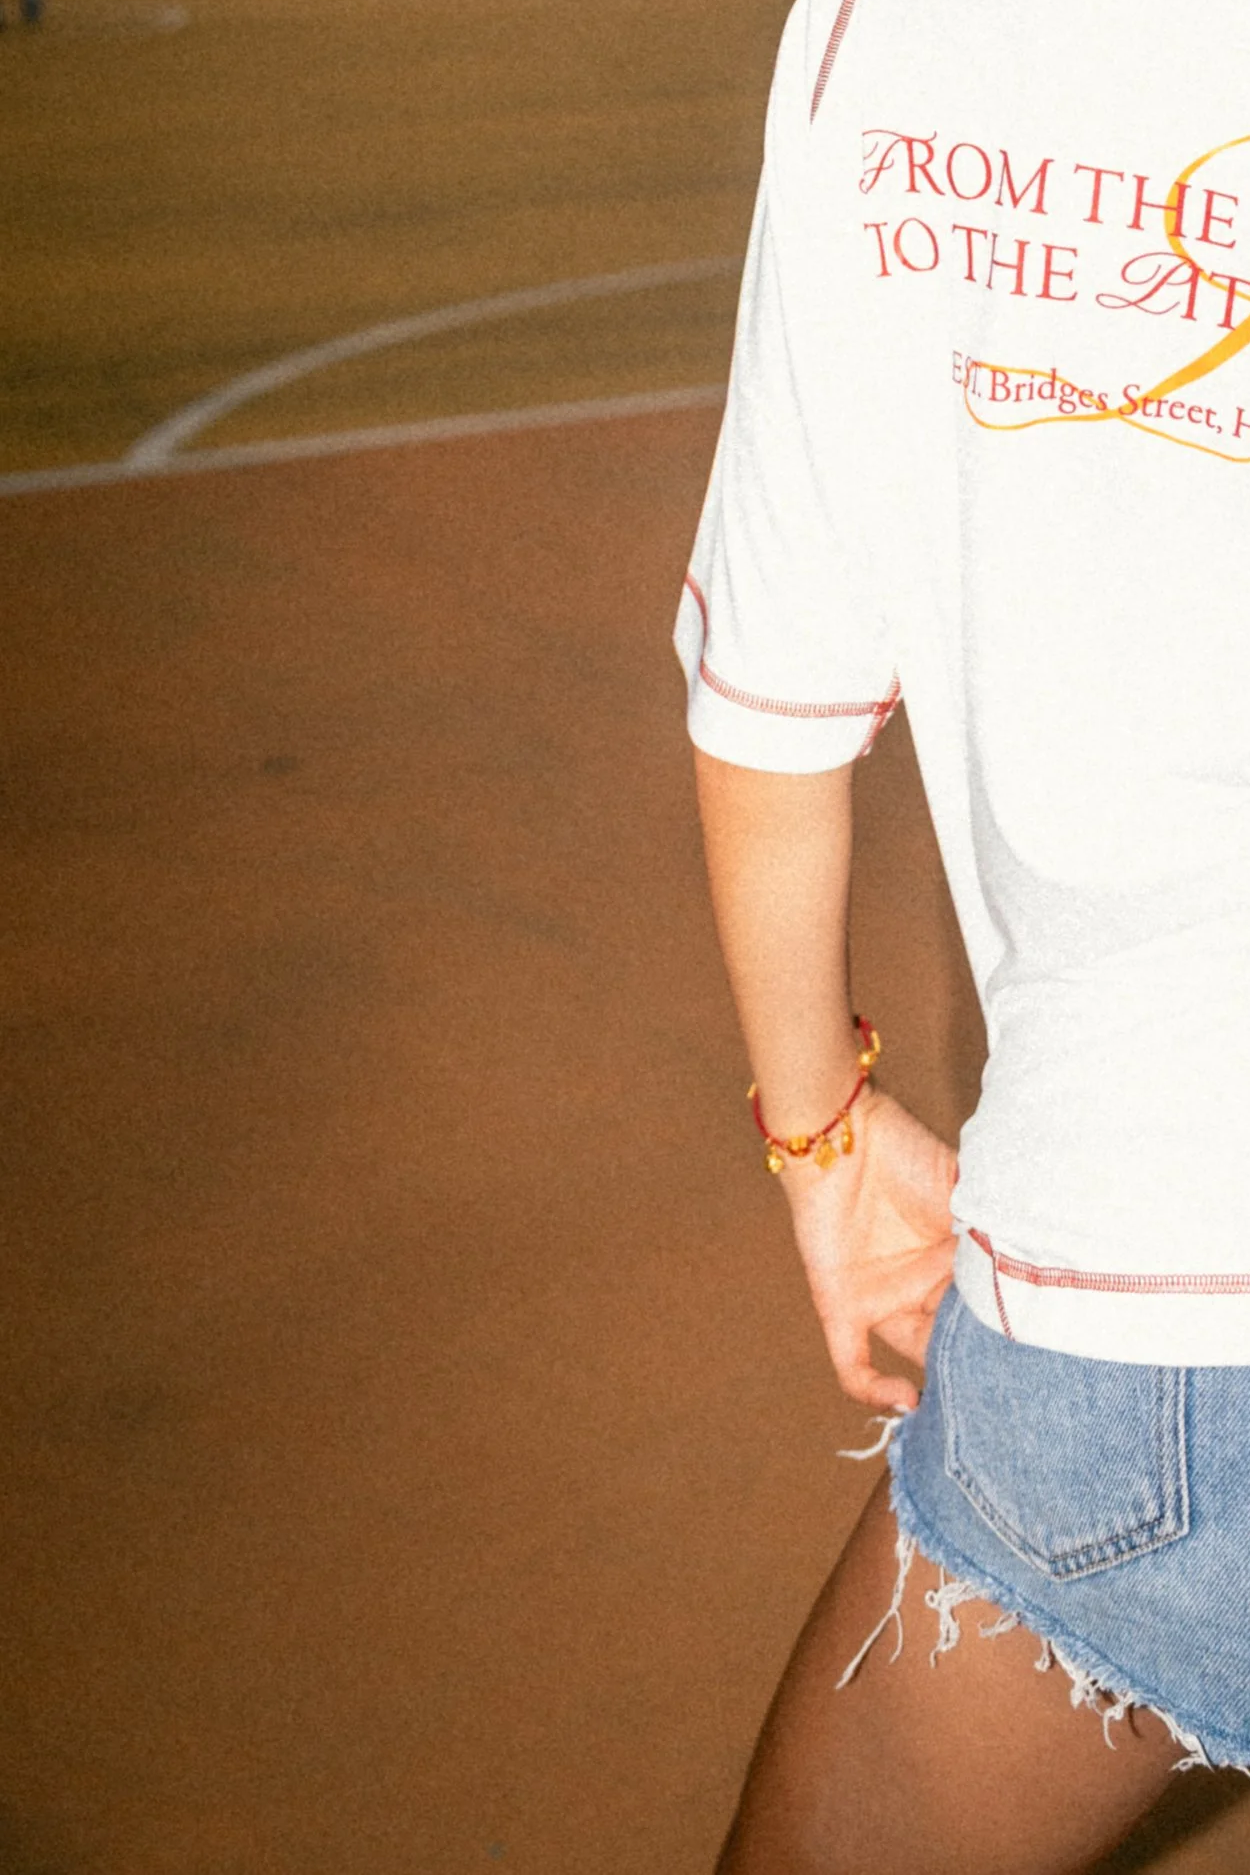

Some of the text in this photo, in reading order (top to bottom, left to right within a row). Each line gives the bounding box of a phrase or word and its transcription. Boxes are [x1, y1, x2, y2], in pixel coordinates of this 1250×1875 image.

[859, 129, 1054, 215] FROM
[1074, 163, 1239, 249] THE
[864, 217, 939, 277] TO
[952, 224, 1078, 301] THE
[988, 368, 1108, 415] Bridges
[1118, 383, 1224, 434] Street,
